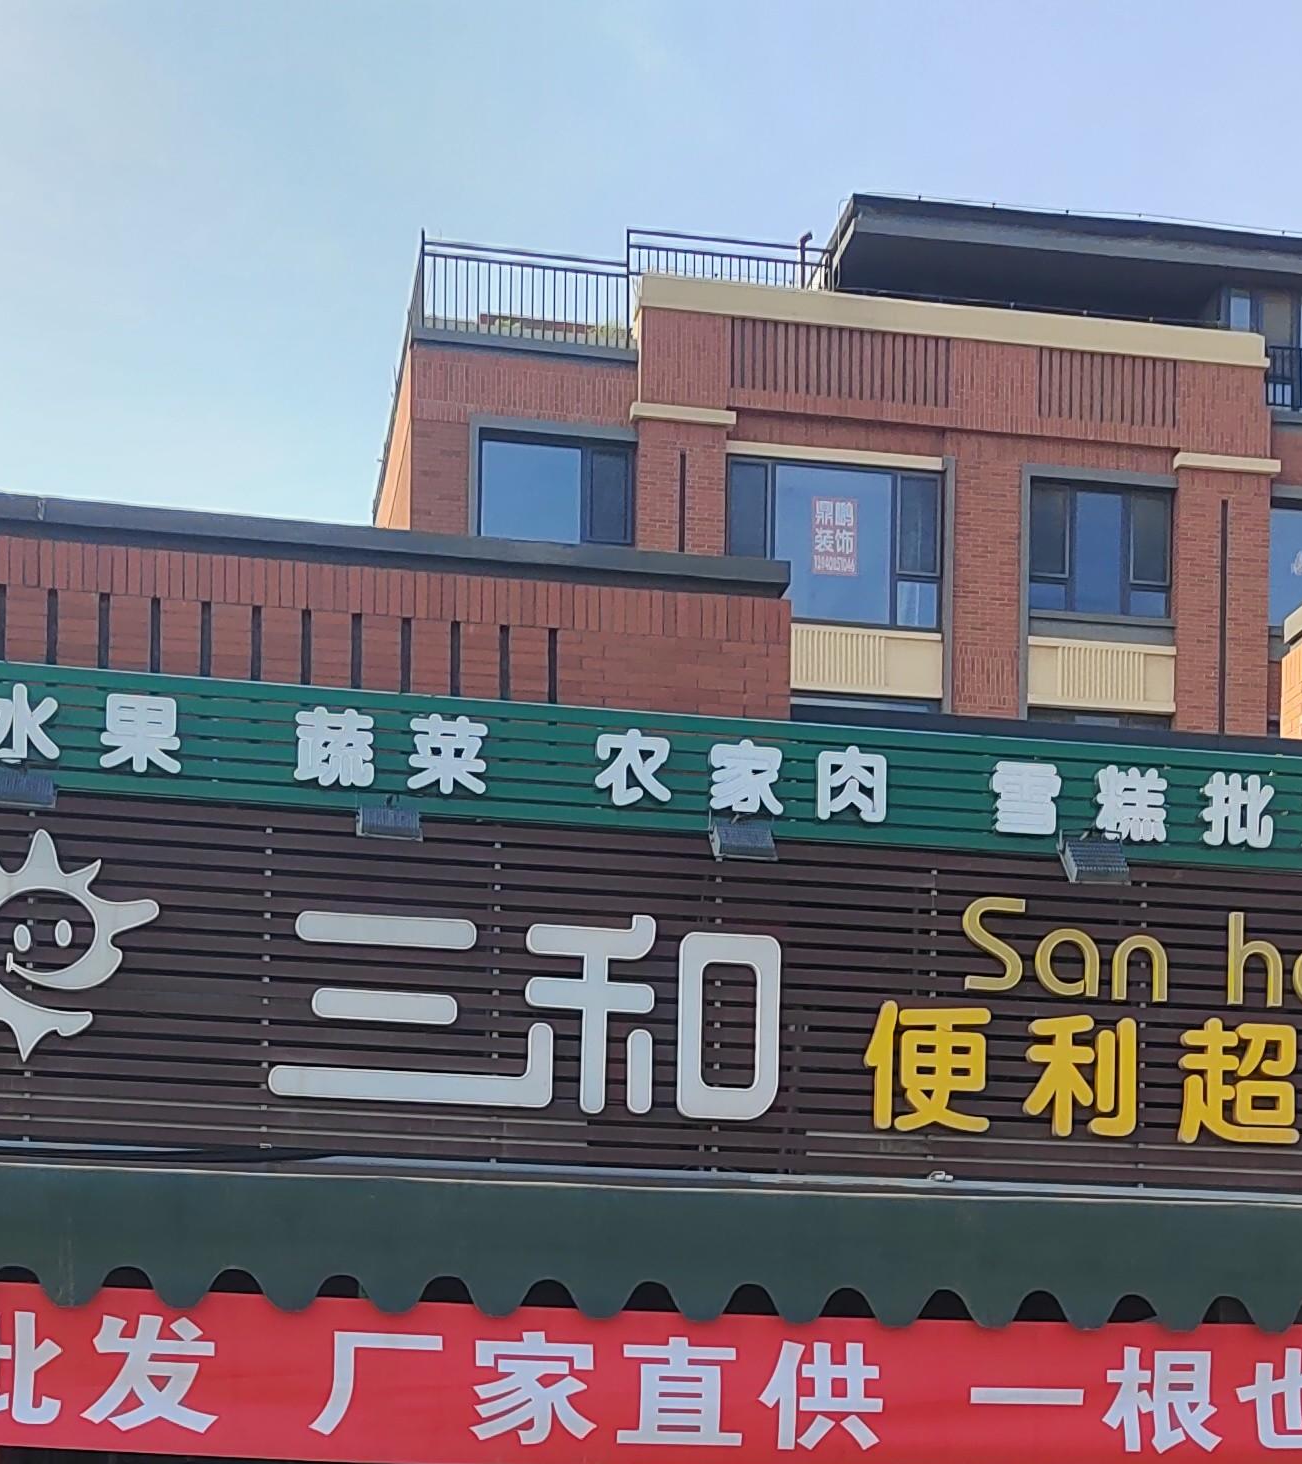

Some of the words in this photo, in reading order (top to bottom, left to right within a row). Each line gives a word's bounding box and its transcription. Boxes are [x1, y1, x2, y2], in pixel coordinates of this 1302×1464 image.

[814, 528, 854, 554] 装饰
[294, 705, 489, 796] 蔬菜
[594, 729, 888, 824] 农家肉
[961, 896, 1170, 1004] San
[267, 910, 782, 1121] 三和
[309, 1330, 885, 1452] 厂家直供
